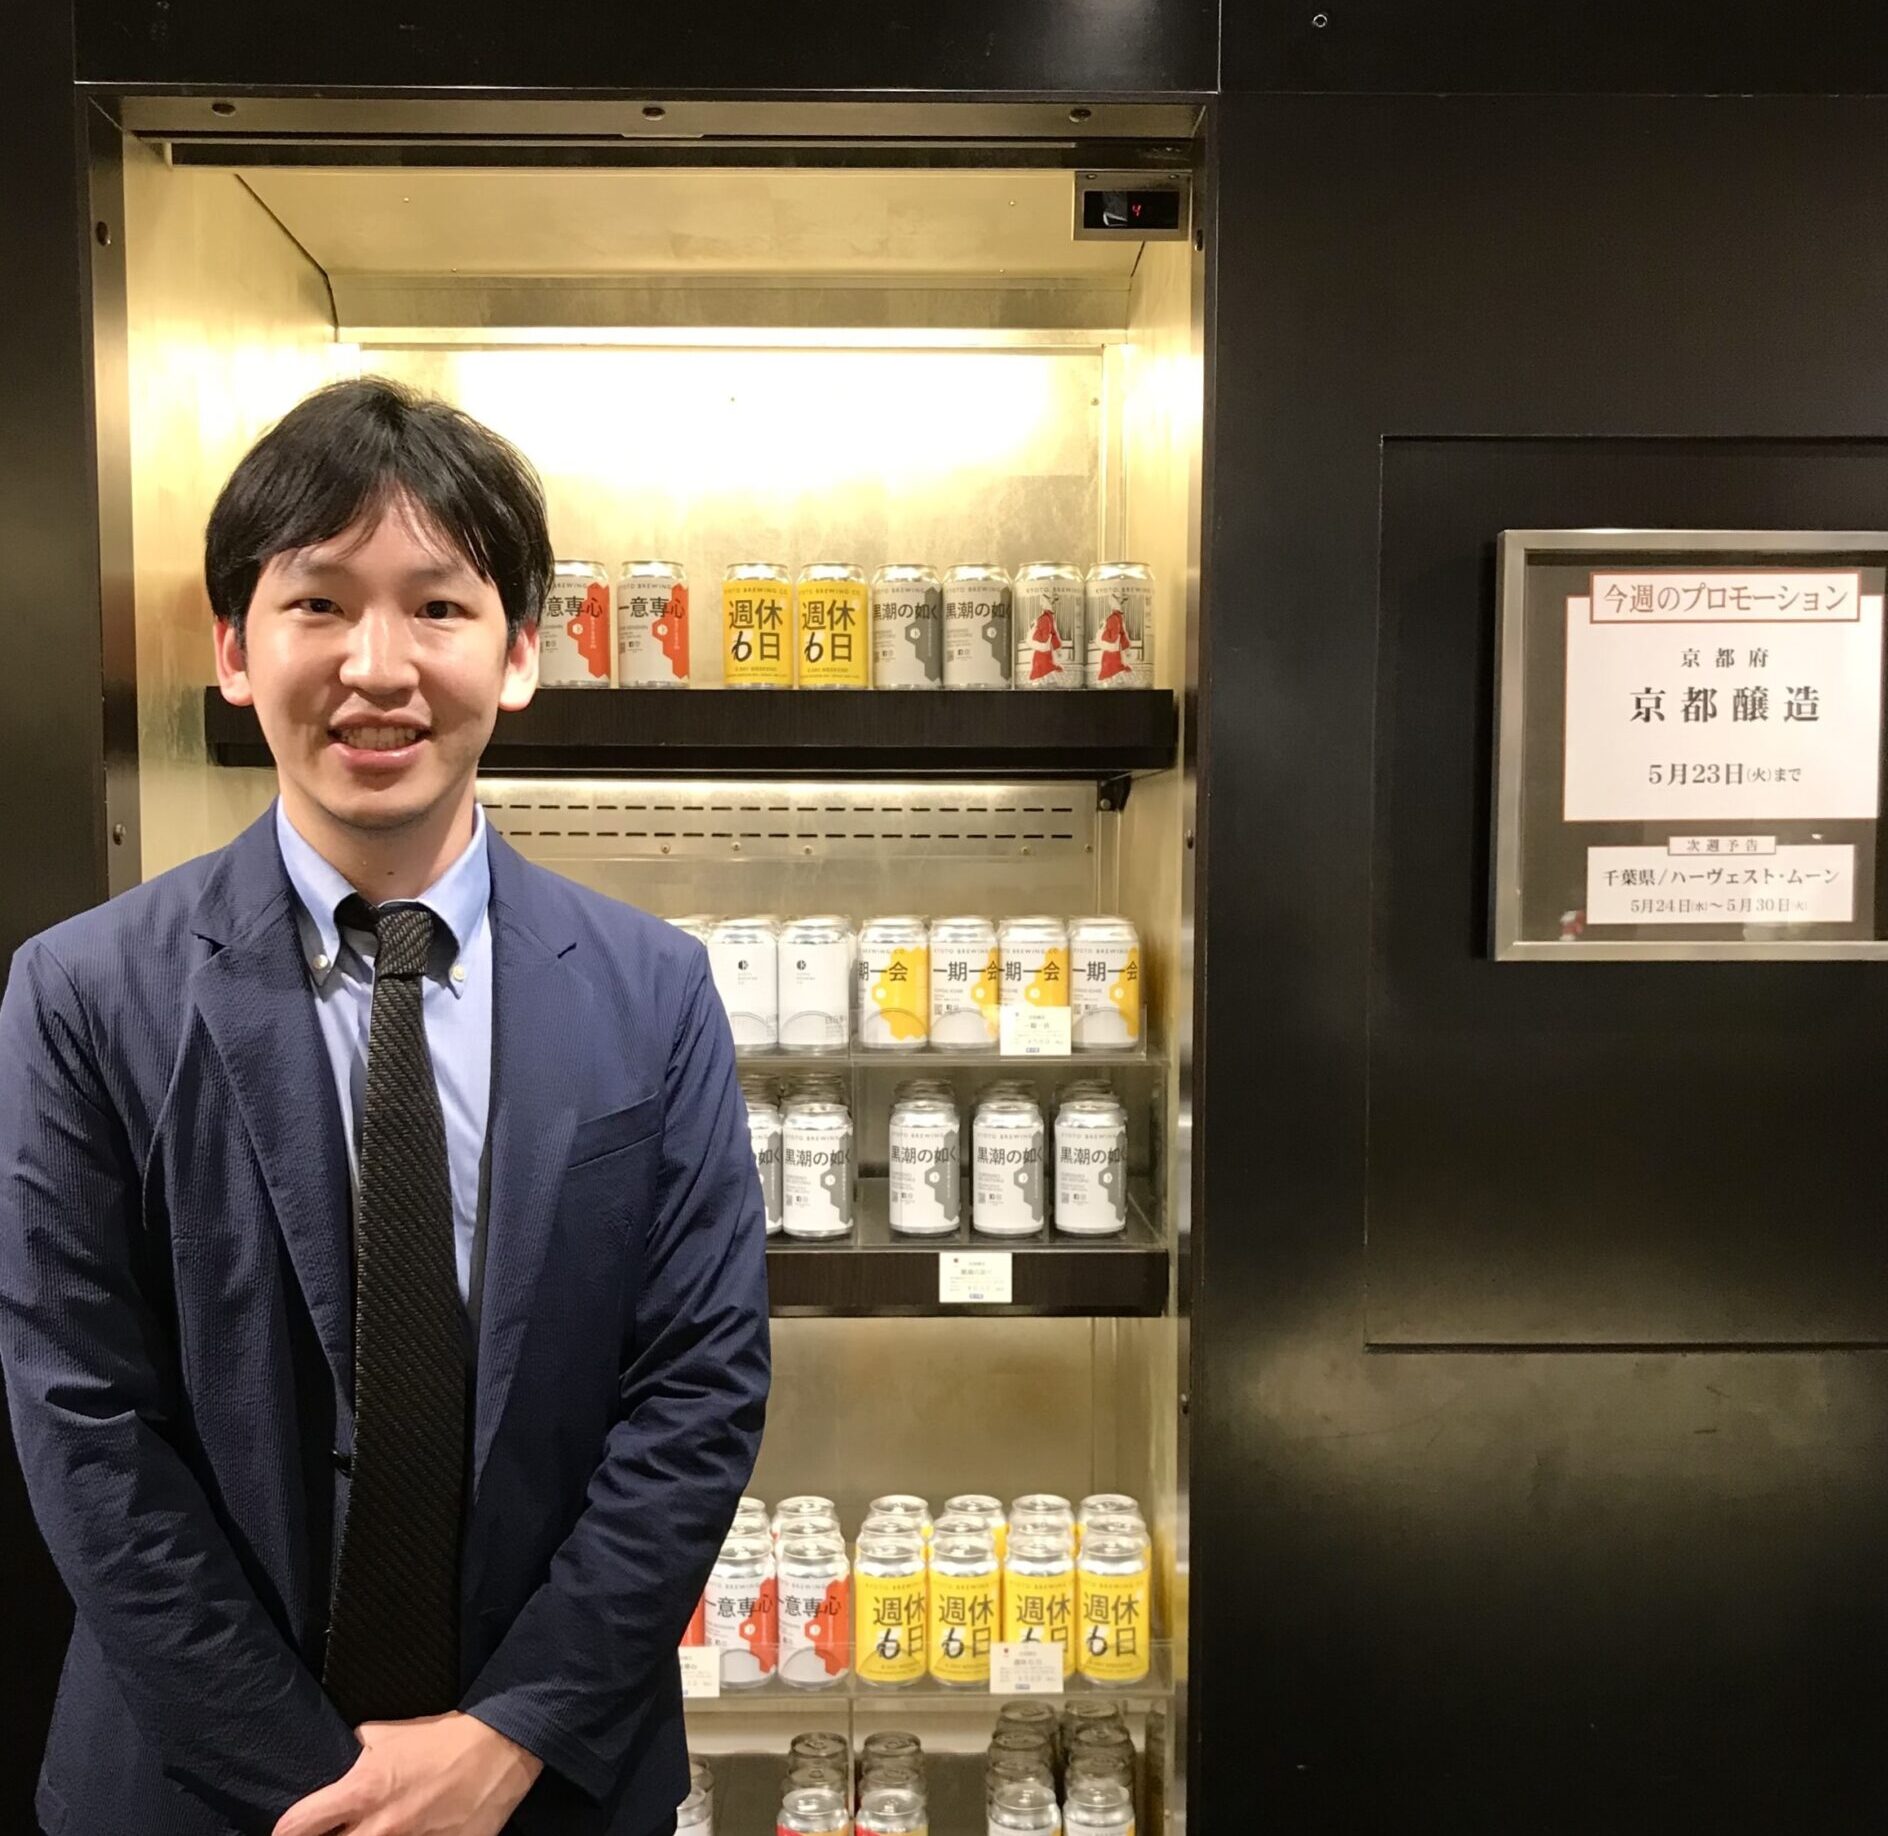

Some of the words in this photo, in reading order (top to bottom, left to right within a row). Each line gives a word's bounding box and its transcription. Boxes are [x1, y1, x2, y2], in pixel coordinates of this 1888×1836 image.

[544, 596, 603, 618] 意専心
[618, 596, 685, 619] 一意専心
[1604, 581, 1848, 614] 今週のプロモーション
[728, 598, 783, 630] 週休
[802, 599, 856, 631] 週休
[872, 602, 938, 620] 黒潮の如く
[731, 631, 780, 662] 6日
[804, 632, 852, 663] 6日
[1681, 647, 1769, 668] 京都府
[1629, 685, 1820, 723] 京都醸造
[1648, 763, 1802, 786] 5月23日(火)まで
[1686, 839, 1758, 853] 次週予告
[1603, 867, 1840, 887] 千葉県/ハーヴェスト・ムーン
[933, 961, 998, 982] 一期一会
[999, 961, 1060, 981] 一期一会
[1072, 961, 1138, 982] 一期一会
[785, 1148, 850, 1167] 黒潮の如く
[891, 1145, 957, 1164] 黒潮の如く
[977, 1146, 1042, 1165] 黒潮の如く
[1060, 1146, 1125, 1165] 黒潮の如く
[705, 1594, 773, 1618] 一意専心
[778, 1594, 842, 1618] 一意専心
[872, 1592, 926, 1626] 週休
[938, 1593, 995, 1627] 週休
[1016, 1592, 1072, 1626] 週休
[1083, 1592, 1139, 1626] 週休
[876, 1624, 924, 1660] 6日
[941, 1627, 992, 1660] 6日
[1086, 1625, 1137, 1657] 6日
